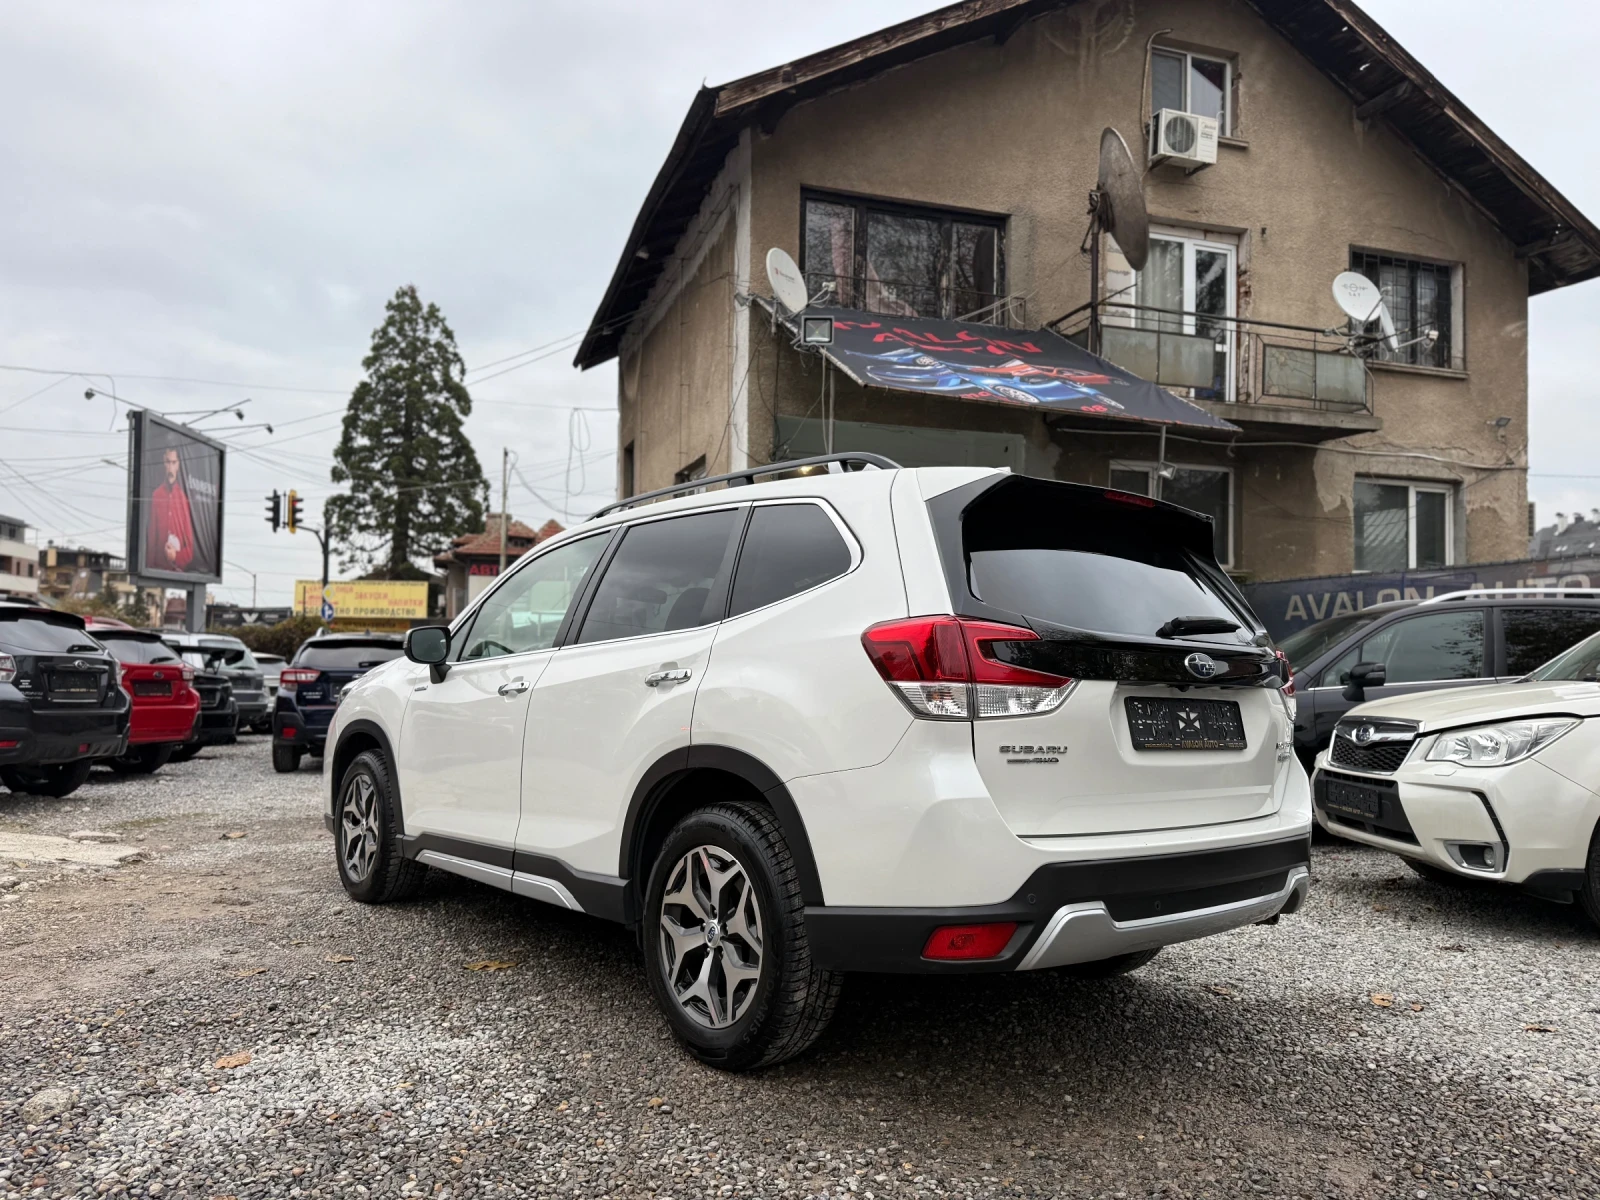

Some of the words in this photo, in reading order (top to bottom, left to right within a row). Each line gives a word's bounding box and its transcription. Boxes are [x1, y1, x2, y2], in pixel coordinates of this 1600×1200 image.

[1284, 585, 1434, 621] AVALON
[1464, 574, 1591, 600] AUTO
[353, 607, 416, 617] ПРОИЗВОДСТВО
[999, 744, 1068, 754] SUBARU
